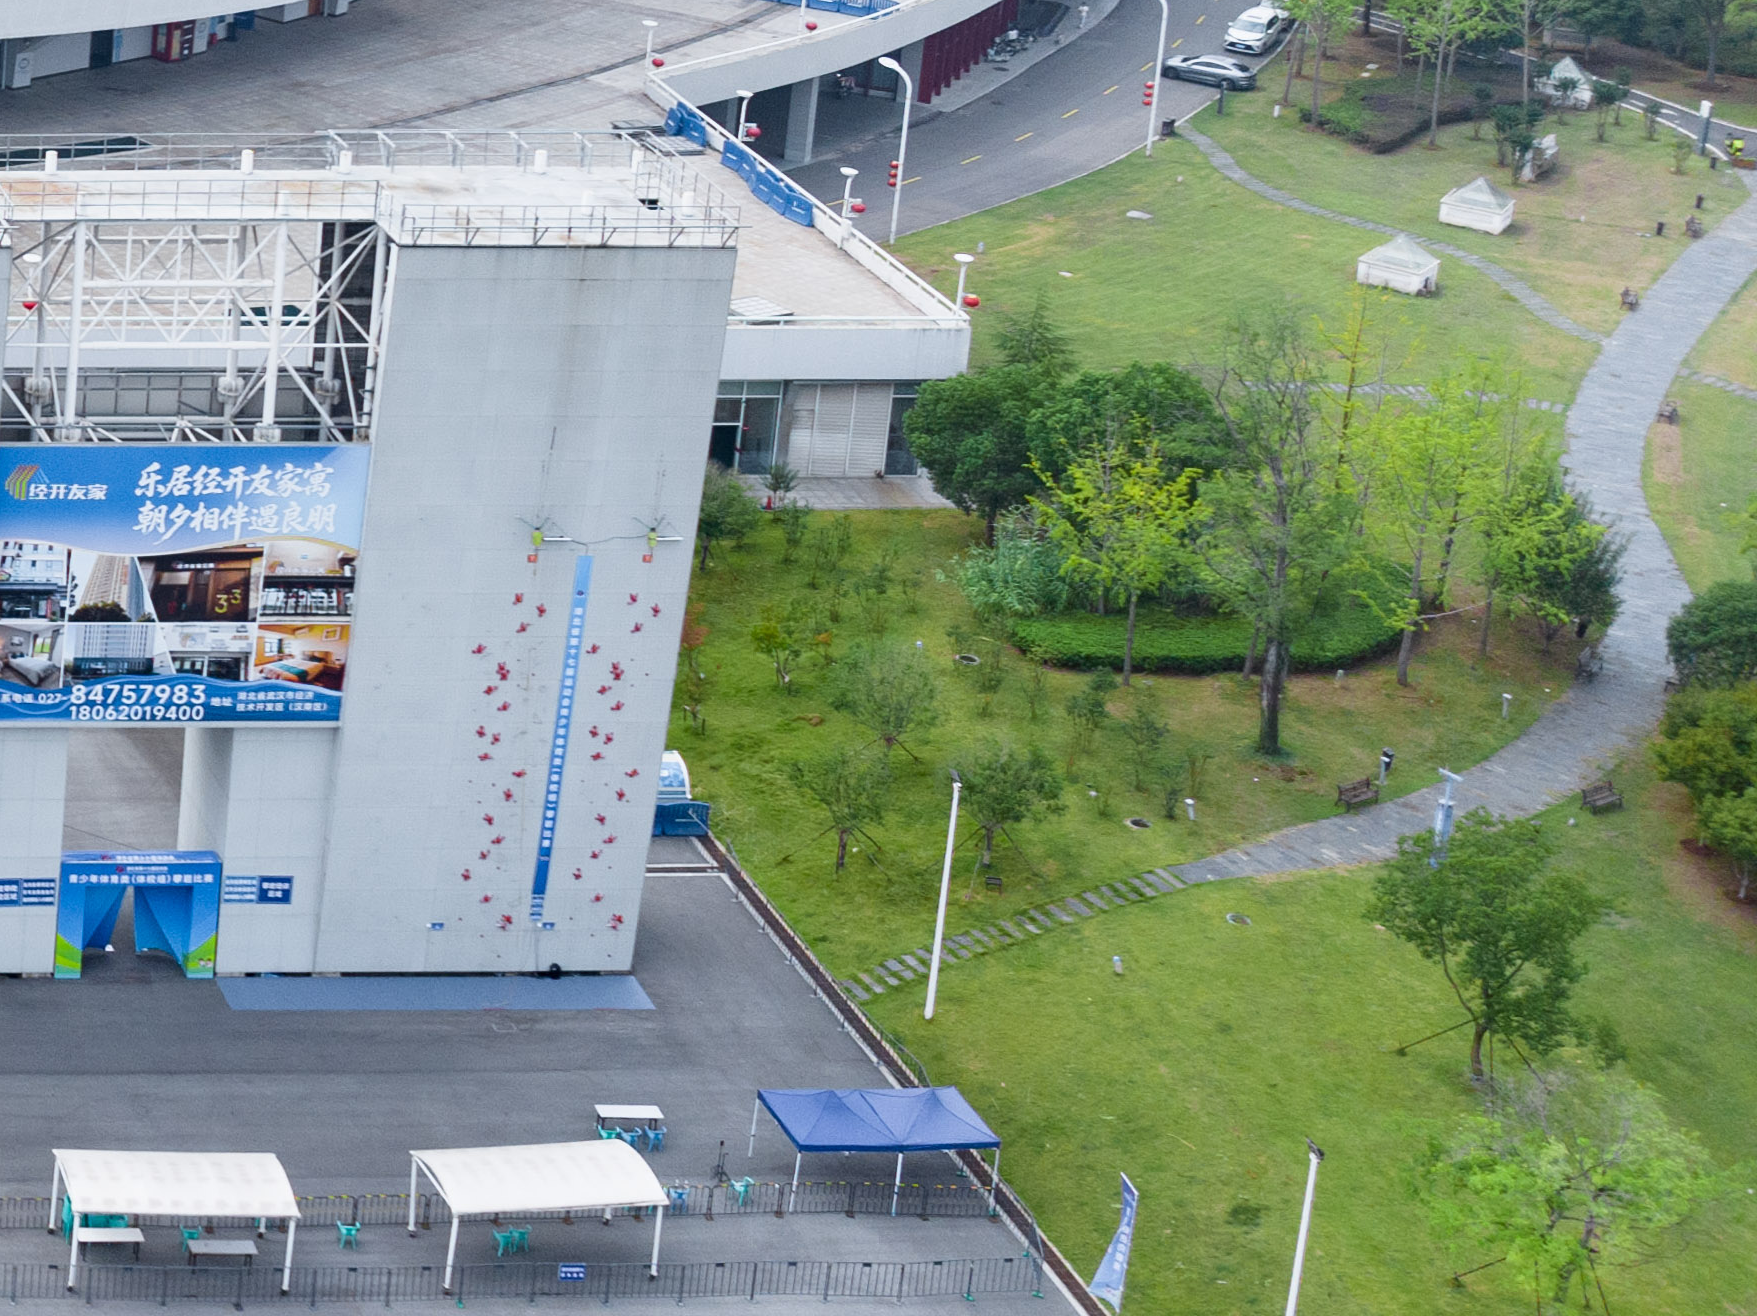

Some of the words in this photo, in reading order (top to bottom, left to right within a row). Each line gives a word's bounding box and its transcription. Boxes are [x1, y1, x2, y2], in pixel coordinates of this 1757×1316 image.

[29, 484, 108, 501] 经开友家
[134, 462, 334, 499] 乐居经开友家寓
[133, 501, 337, 546] 朝夕相伴遇良朋
[69, 705, 205, 720] 18062019400
